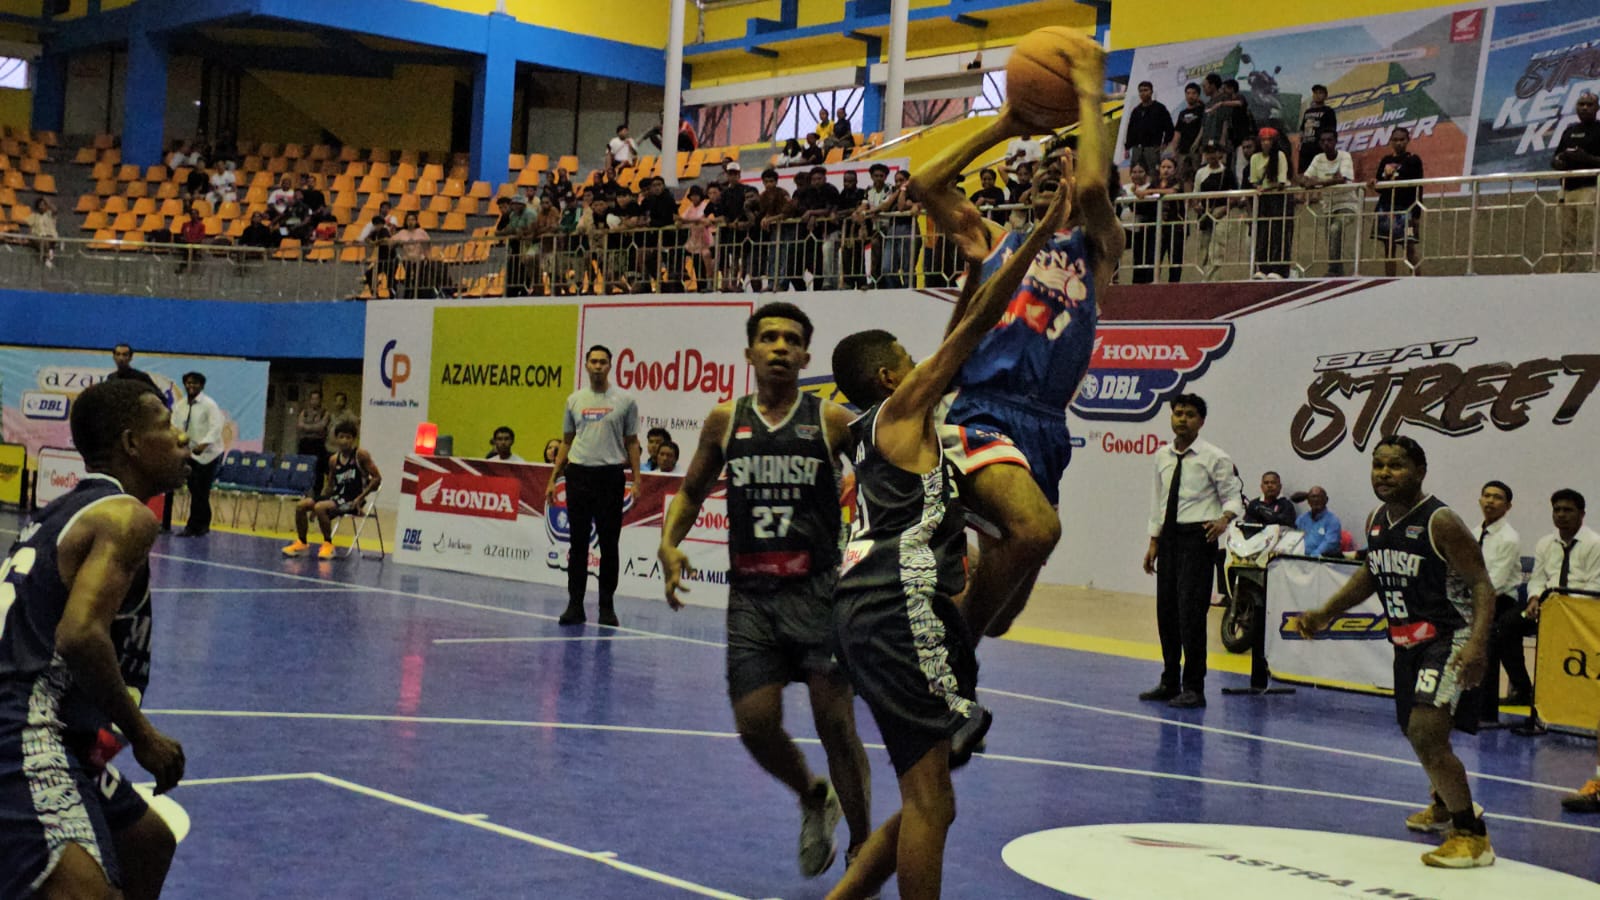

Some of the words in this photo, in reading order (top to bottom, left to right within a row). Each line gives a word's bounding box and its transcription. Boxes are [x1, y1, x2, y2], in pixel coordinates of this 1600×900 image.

[1102, 344, 1189, 361] HONDA
[441, 363, 562, 388] AZAWEAR.COM
[1098, 375, 1142, 400] DBL
[38, 399, 63, 411] DBL
[1290, 354, 1600, 460] STREET
[729, 454, 825, 488] SMANSA
[440, 488, 514, 514] HONDA
[753, 505, 794, 539] 27
[402, 528, 422, 545] DBL
[1367, 548, 1427, 578] SMANSA
[1563, 647, 1600, 681] a
[1207, 853, 1355, 888] ASTRA
